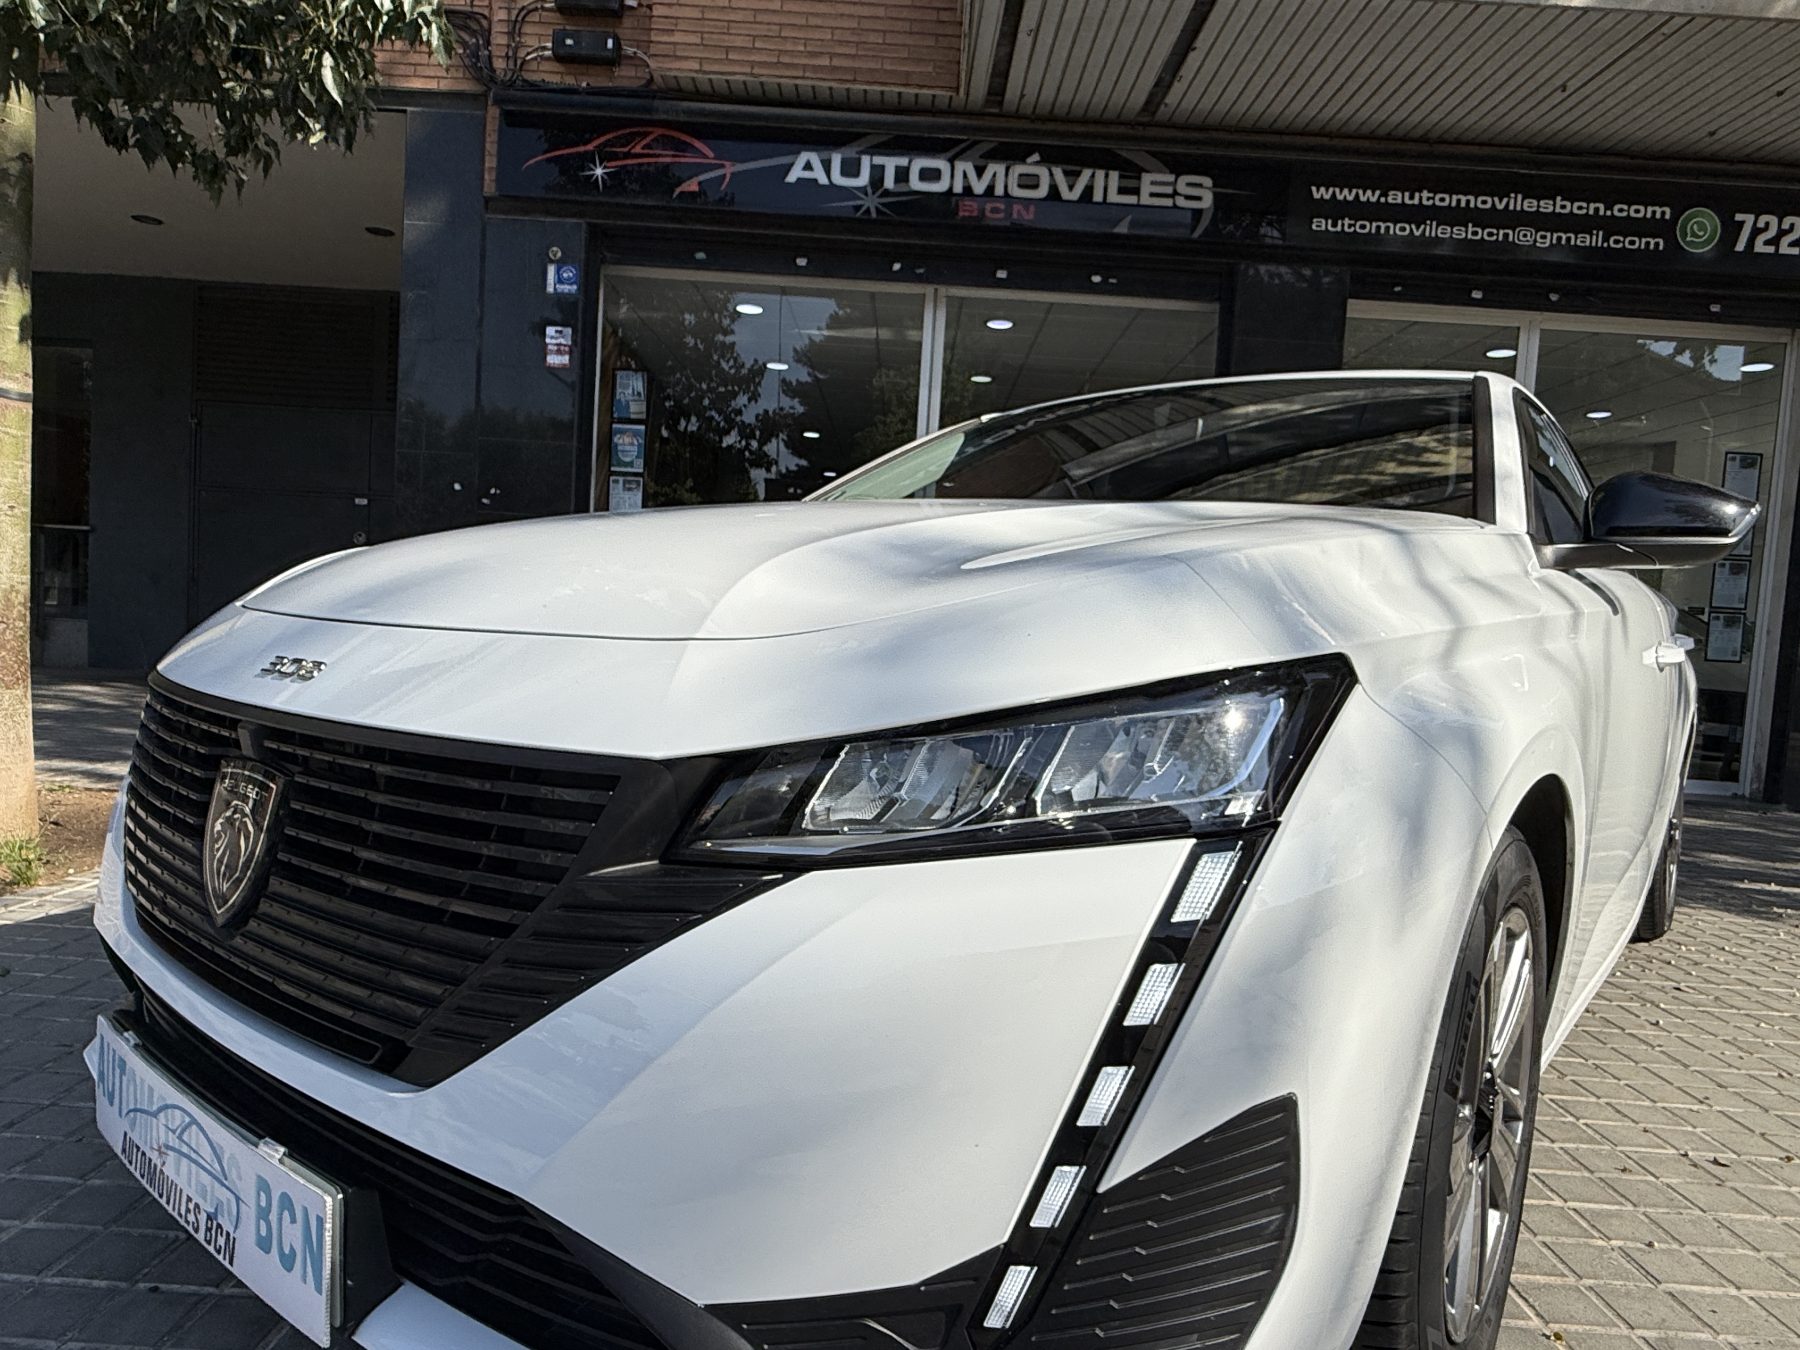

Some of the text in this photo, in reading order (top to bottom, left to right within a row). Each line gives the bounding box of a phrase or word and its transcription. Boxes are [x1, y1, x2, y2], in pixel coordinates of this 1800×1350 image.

[784, 152, 1213, 209] AUTOMÓVILES
[957, 200, 1036, 220] BCN
[1311, 185, 1671, 219] www.automovilesbcn.com
[1311, 217, 1664, 251] automovilesbcn@gmail.com
[1734, 213, 1800, 255] 722
[204, 1213, 236, 1267] BCN
[255, 1174, 324, 1296] BCN
